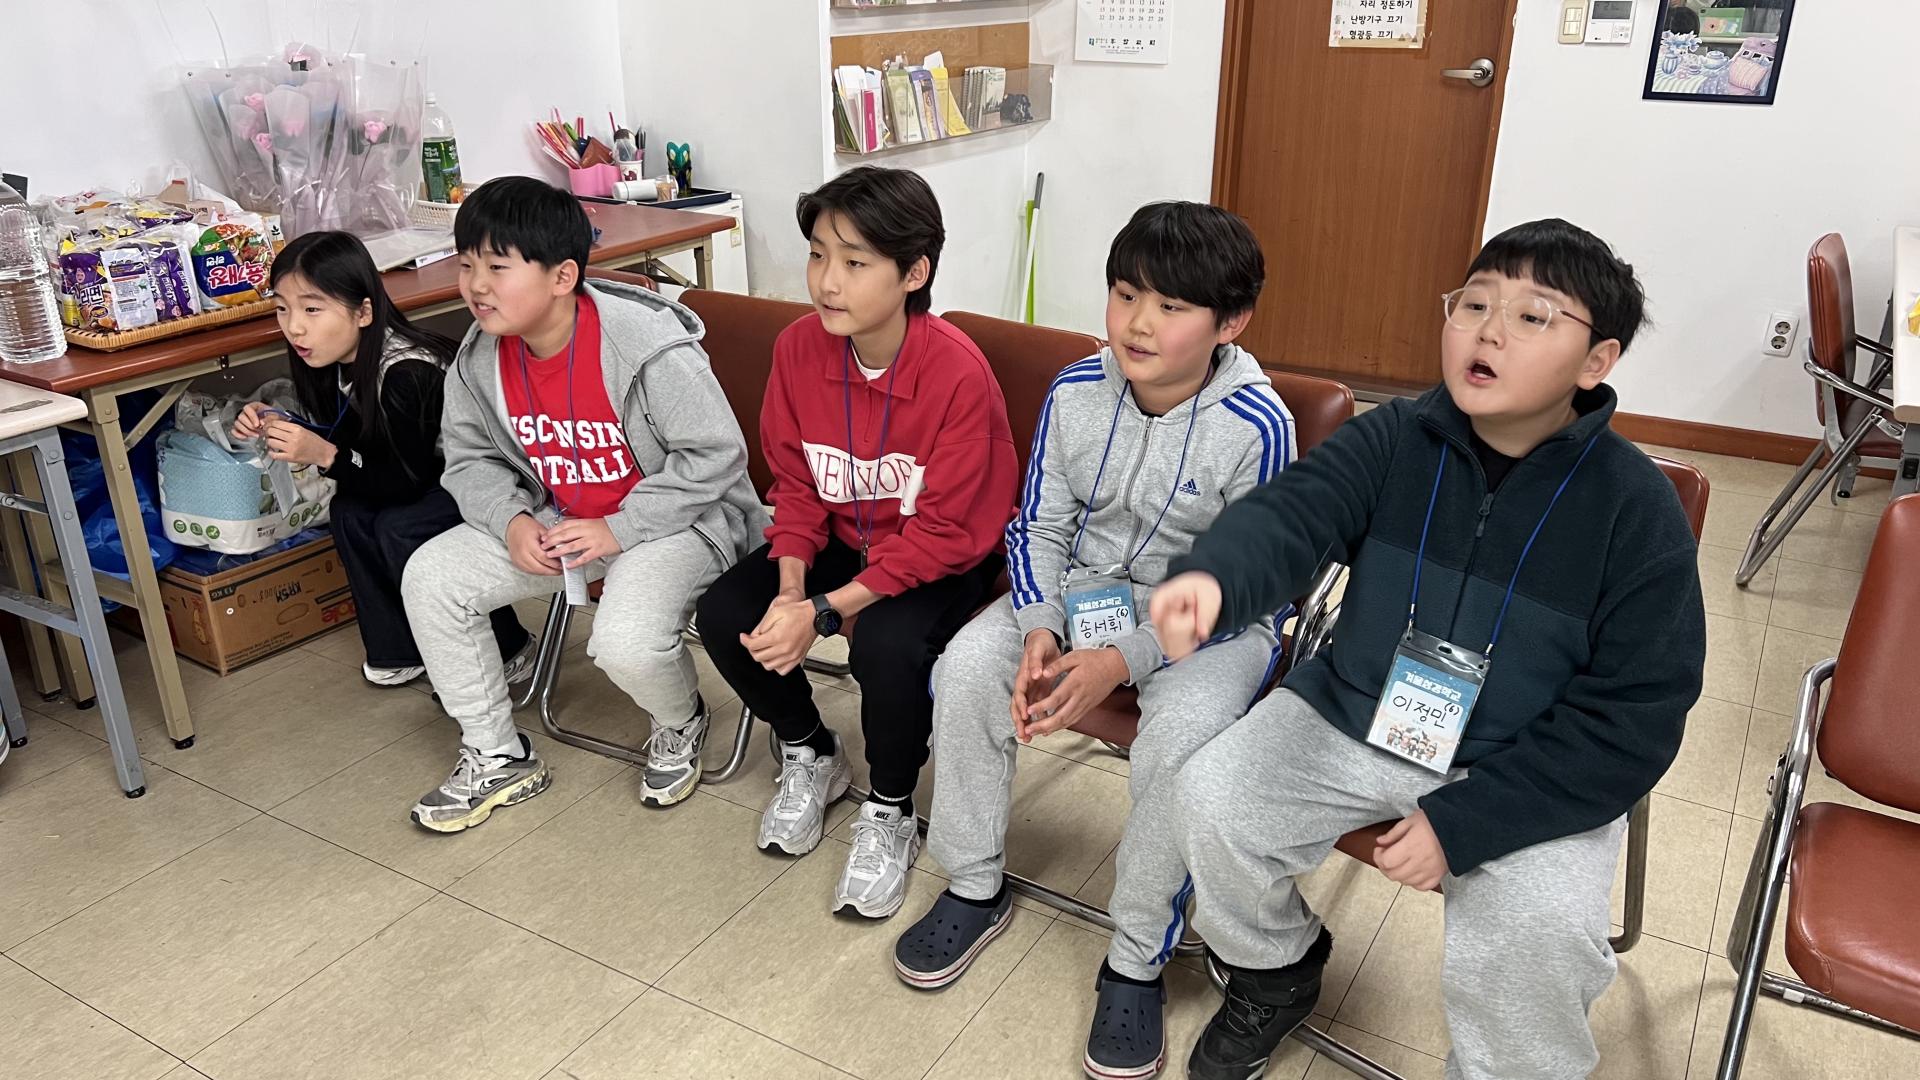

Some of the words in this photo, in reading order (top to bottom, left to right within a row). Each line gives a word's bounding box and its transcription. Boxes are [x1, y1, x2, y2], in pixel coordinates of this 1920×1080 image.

[1360, 0, 1376, 9] 자리
[1380, 0, 1413, 10] 정돈하기
[1350, 15, 1383, 25] 난방기구
[1387, 15, 1403, 24] 끄기
[1349, 30, 1373, 40] 형광등
[1377, 30, 1393, 39] 끄기
[206, 255, 225, 267] 라면
[208, 261, 264, 289] 육개장
[73, 283, 103, 306] 라면
[856, 458, 912, 495] YOR
[1178, 486, 1201, 496] adidas
[1392, 695, 1446, 729] 이정민
[1444, 702, 1460, 716] (6)
[786, 754, 798, 762] NIKE
[874, 810, 890, 820] NIKE
